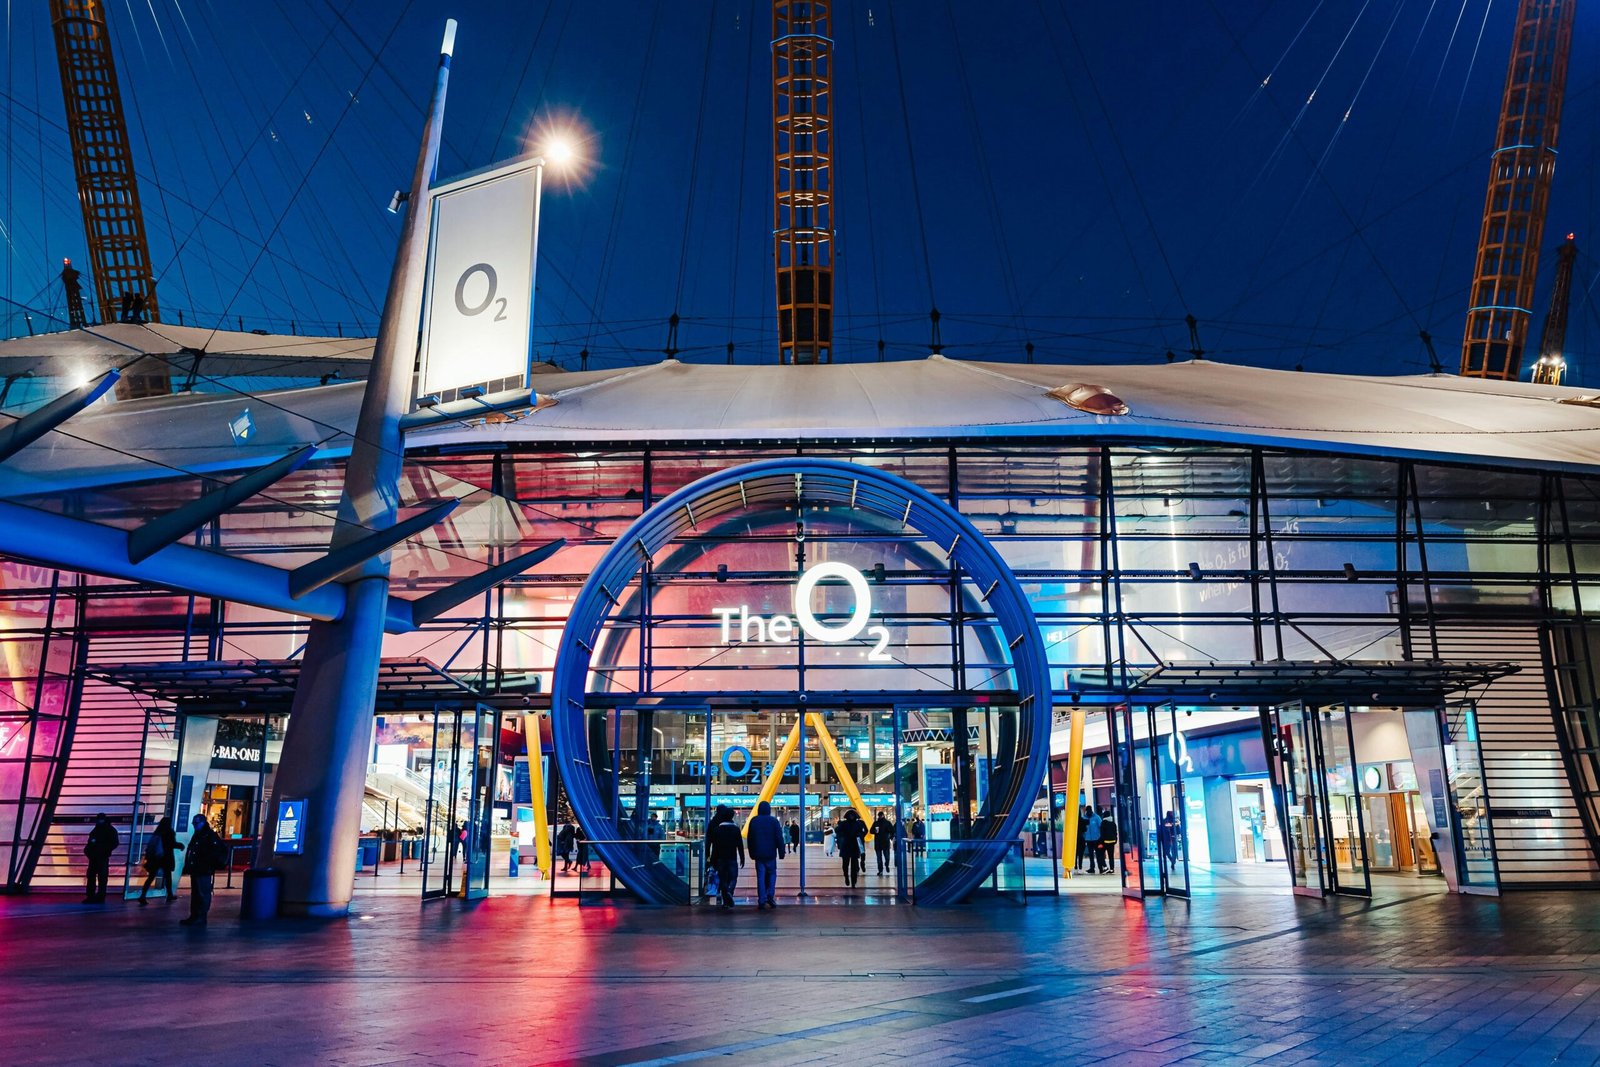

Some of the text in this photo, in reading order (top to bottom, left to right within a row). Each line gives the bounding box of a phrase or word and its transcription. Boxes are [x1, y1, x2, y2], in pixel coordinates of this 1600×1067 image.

[455, 263, 507, 322] O2
[712, 562, 892, 661] The O2
[687, 761, 718, 777] The
[721, 745, 761, 783] O2
